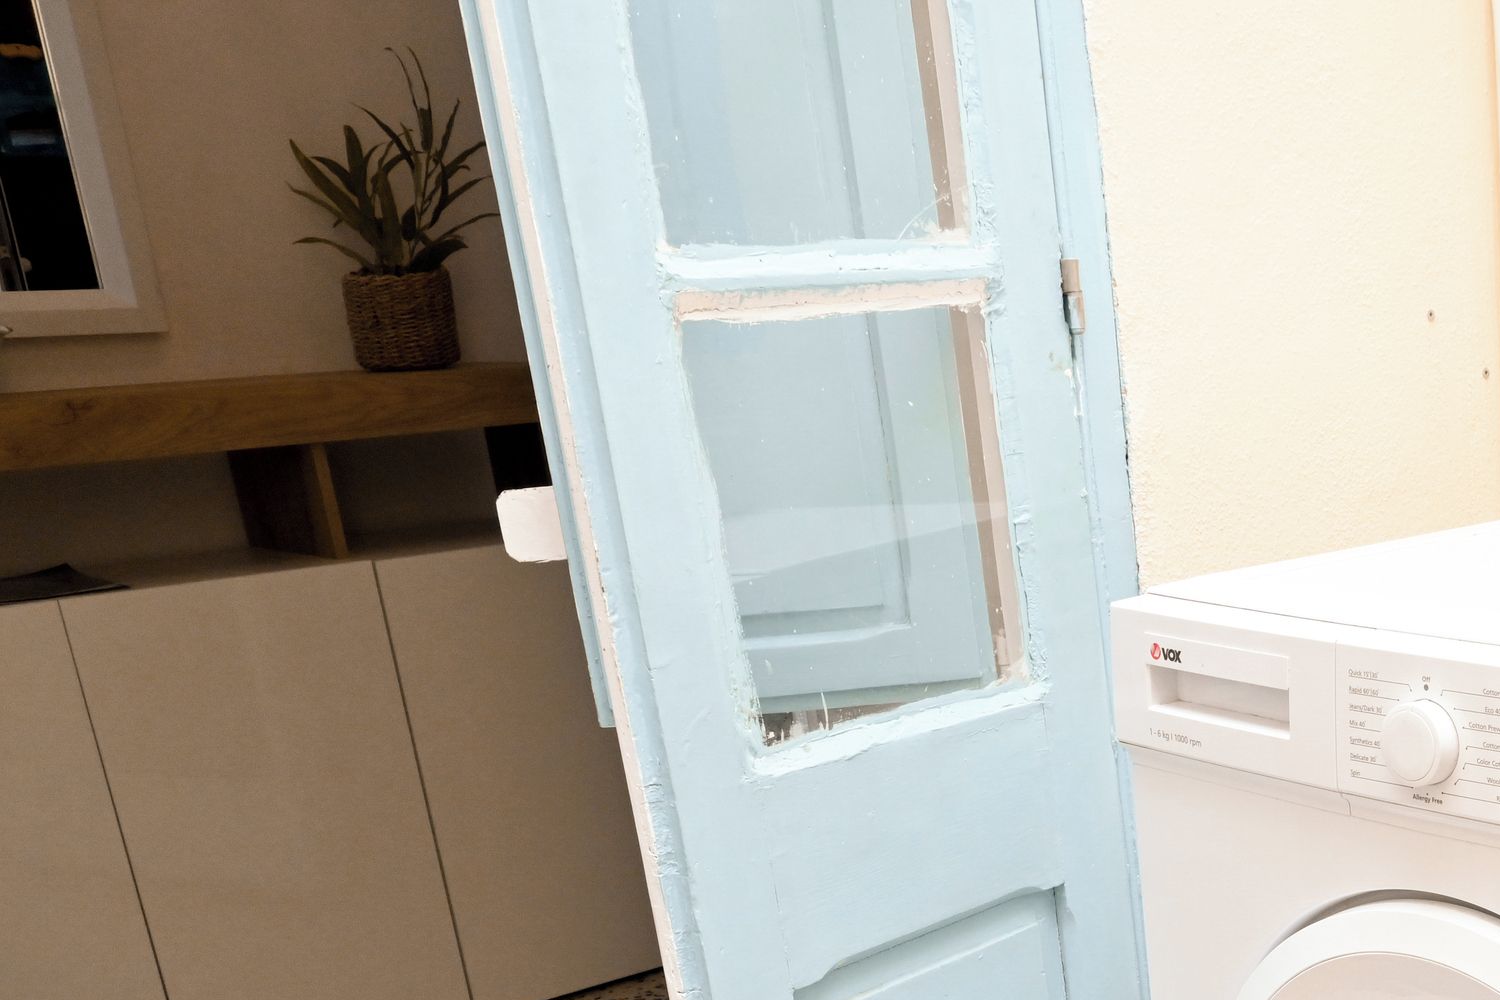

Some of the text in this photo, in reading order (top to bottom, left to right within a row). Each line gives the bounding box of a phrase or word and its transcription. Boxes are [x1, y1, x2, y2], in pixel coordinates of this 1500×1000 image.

[1161, 647, 1182, 664] VOX
[1421, 675, 1431, 683] Off
[1468, 721, 1487, 731] Cotton
[1162, 730, 1170, 741] kg
[1174, 734, 1189, 745] 1000
[1189, 738, 1202, 748] rpm
[1476, 758, 1491, 766] Color
[1486, 776, 1500, 785] Wool
